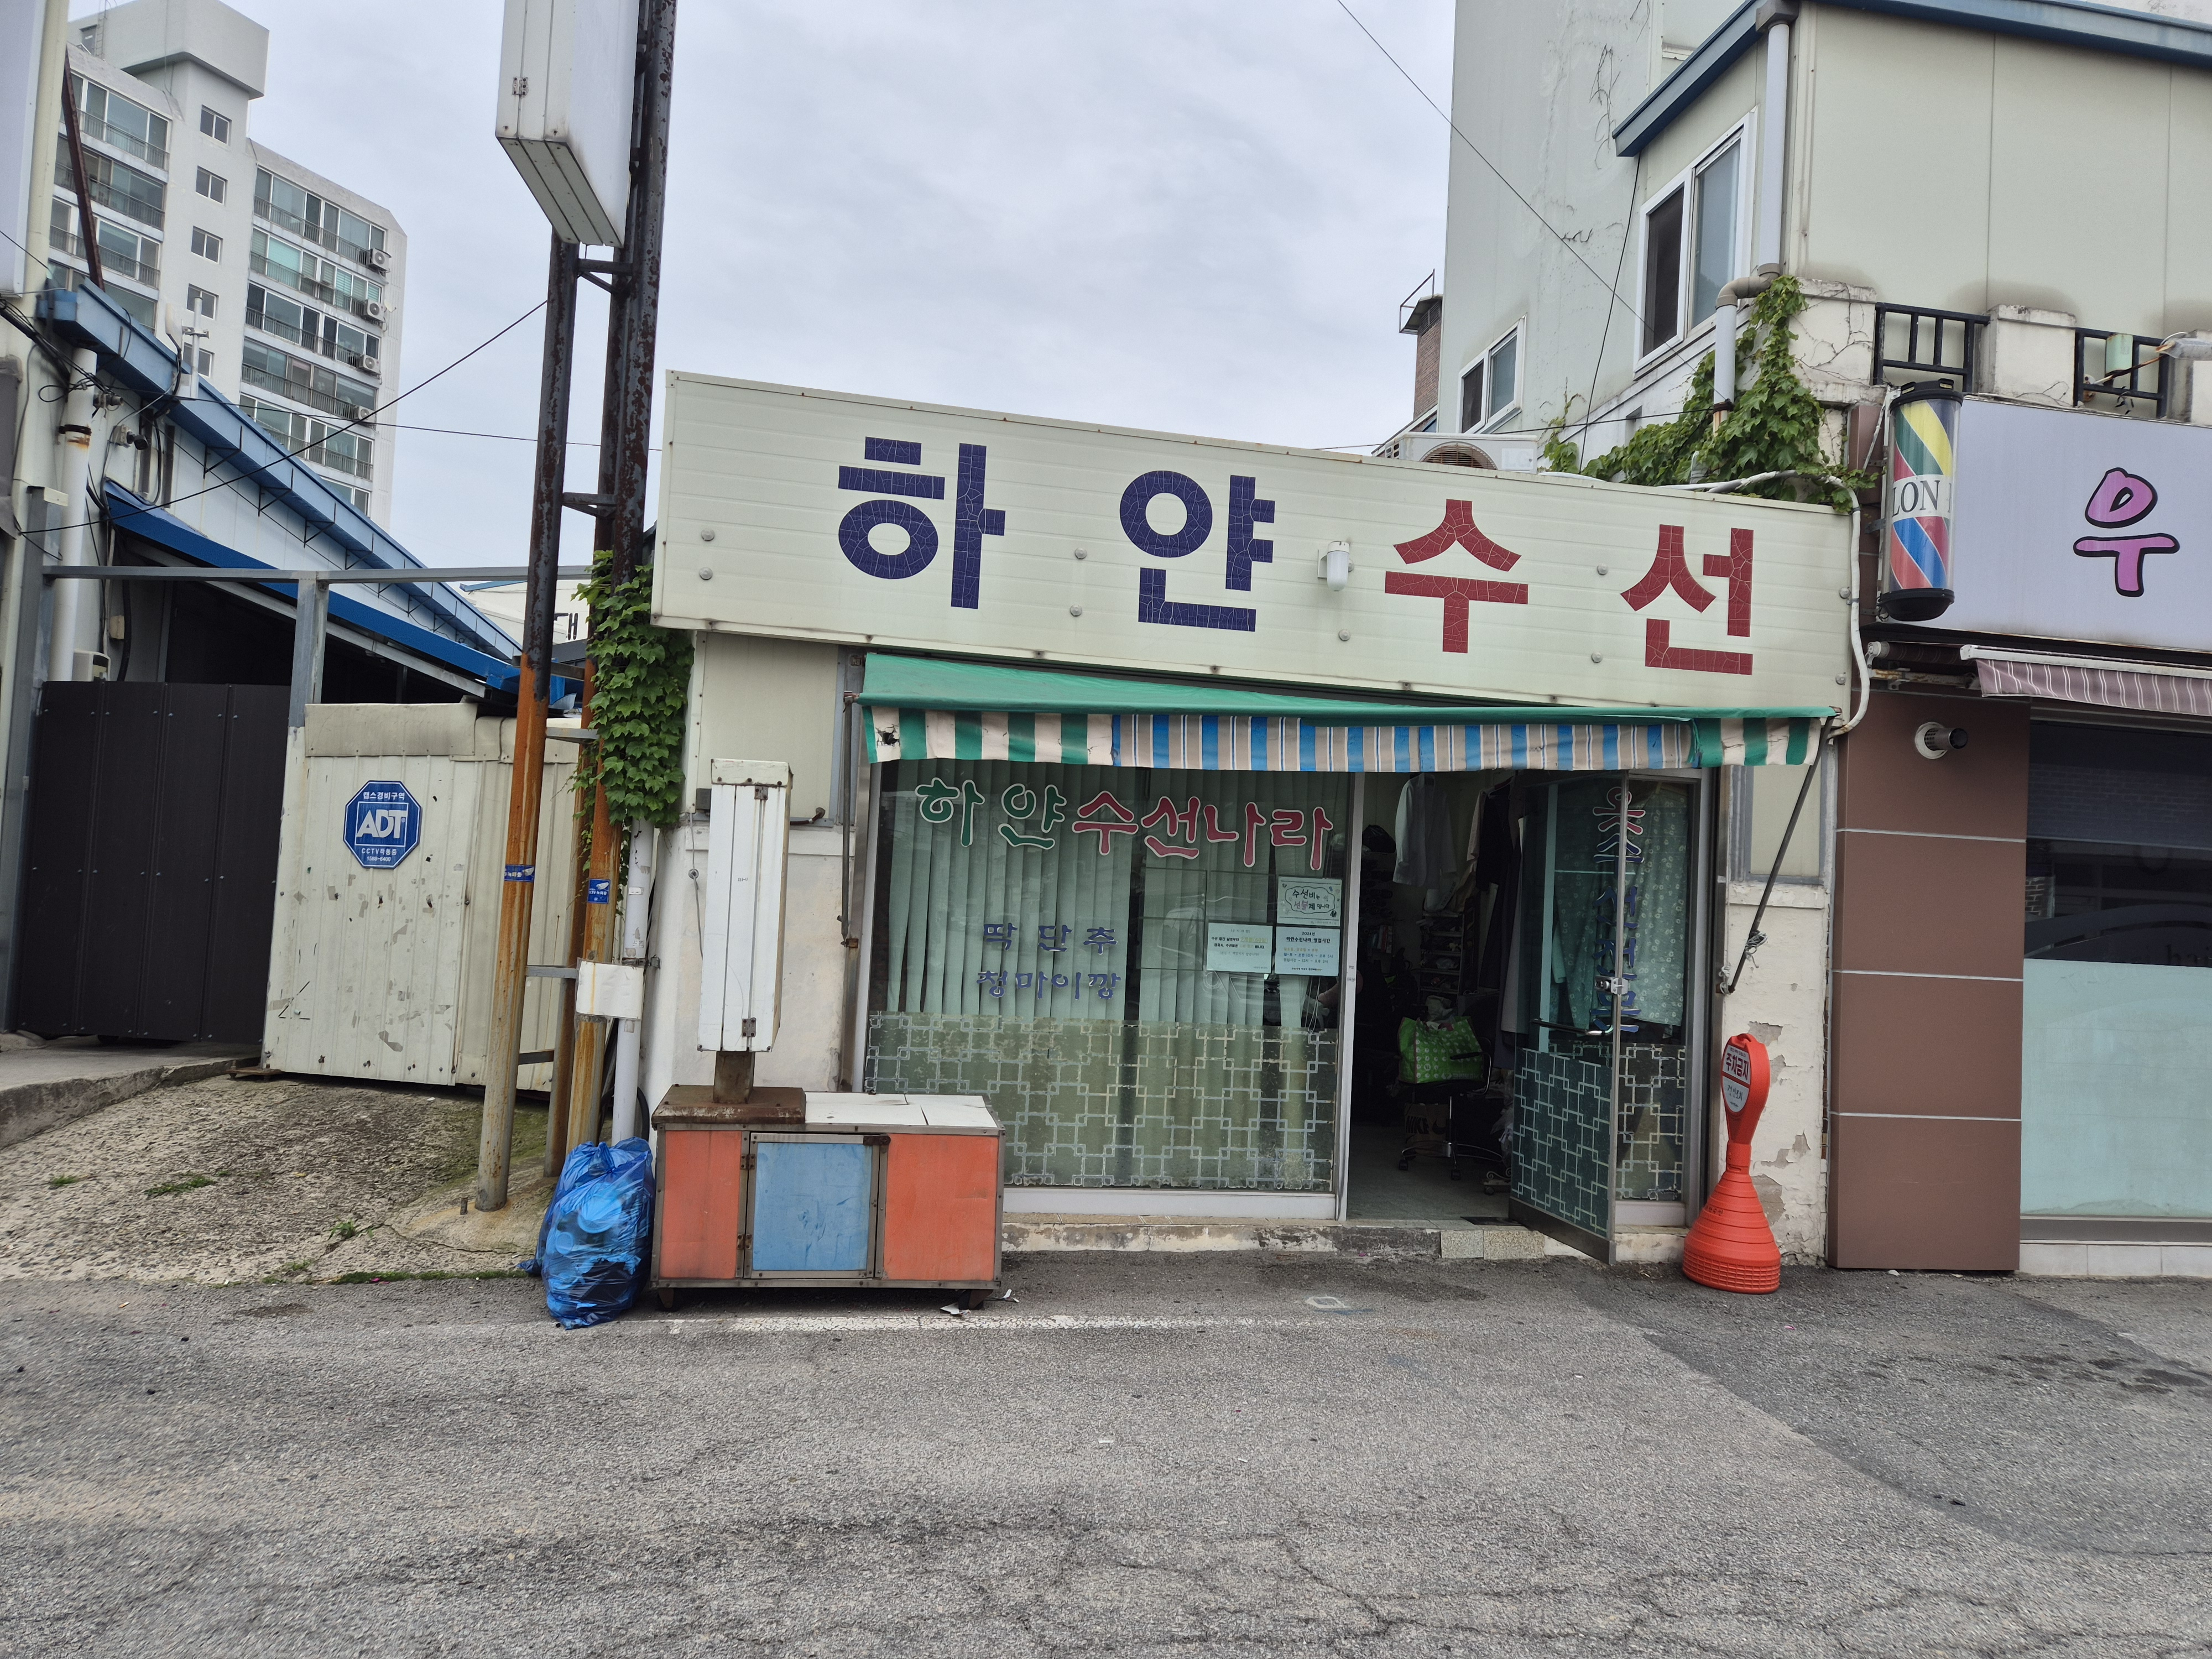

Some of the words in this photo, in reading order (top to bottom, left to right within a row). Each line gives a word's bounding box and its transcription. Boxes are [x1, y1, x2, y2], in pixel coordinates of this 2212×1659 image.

[2074, 468, 2180, 597] 우
[363, 791, 405, 800] 캡스경비구역
[356, 809, 408, 838] ADT
[1292, 889, 1320, 900] 수선비는
[1725, 1052, 1749, 1081] 주차금지
[1727, 1084, 1743, 1101] 견인조치
